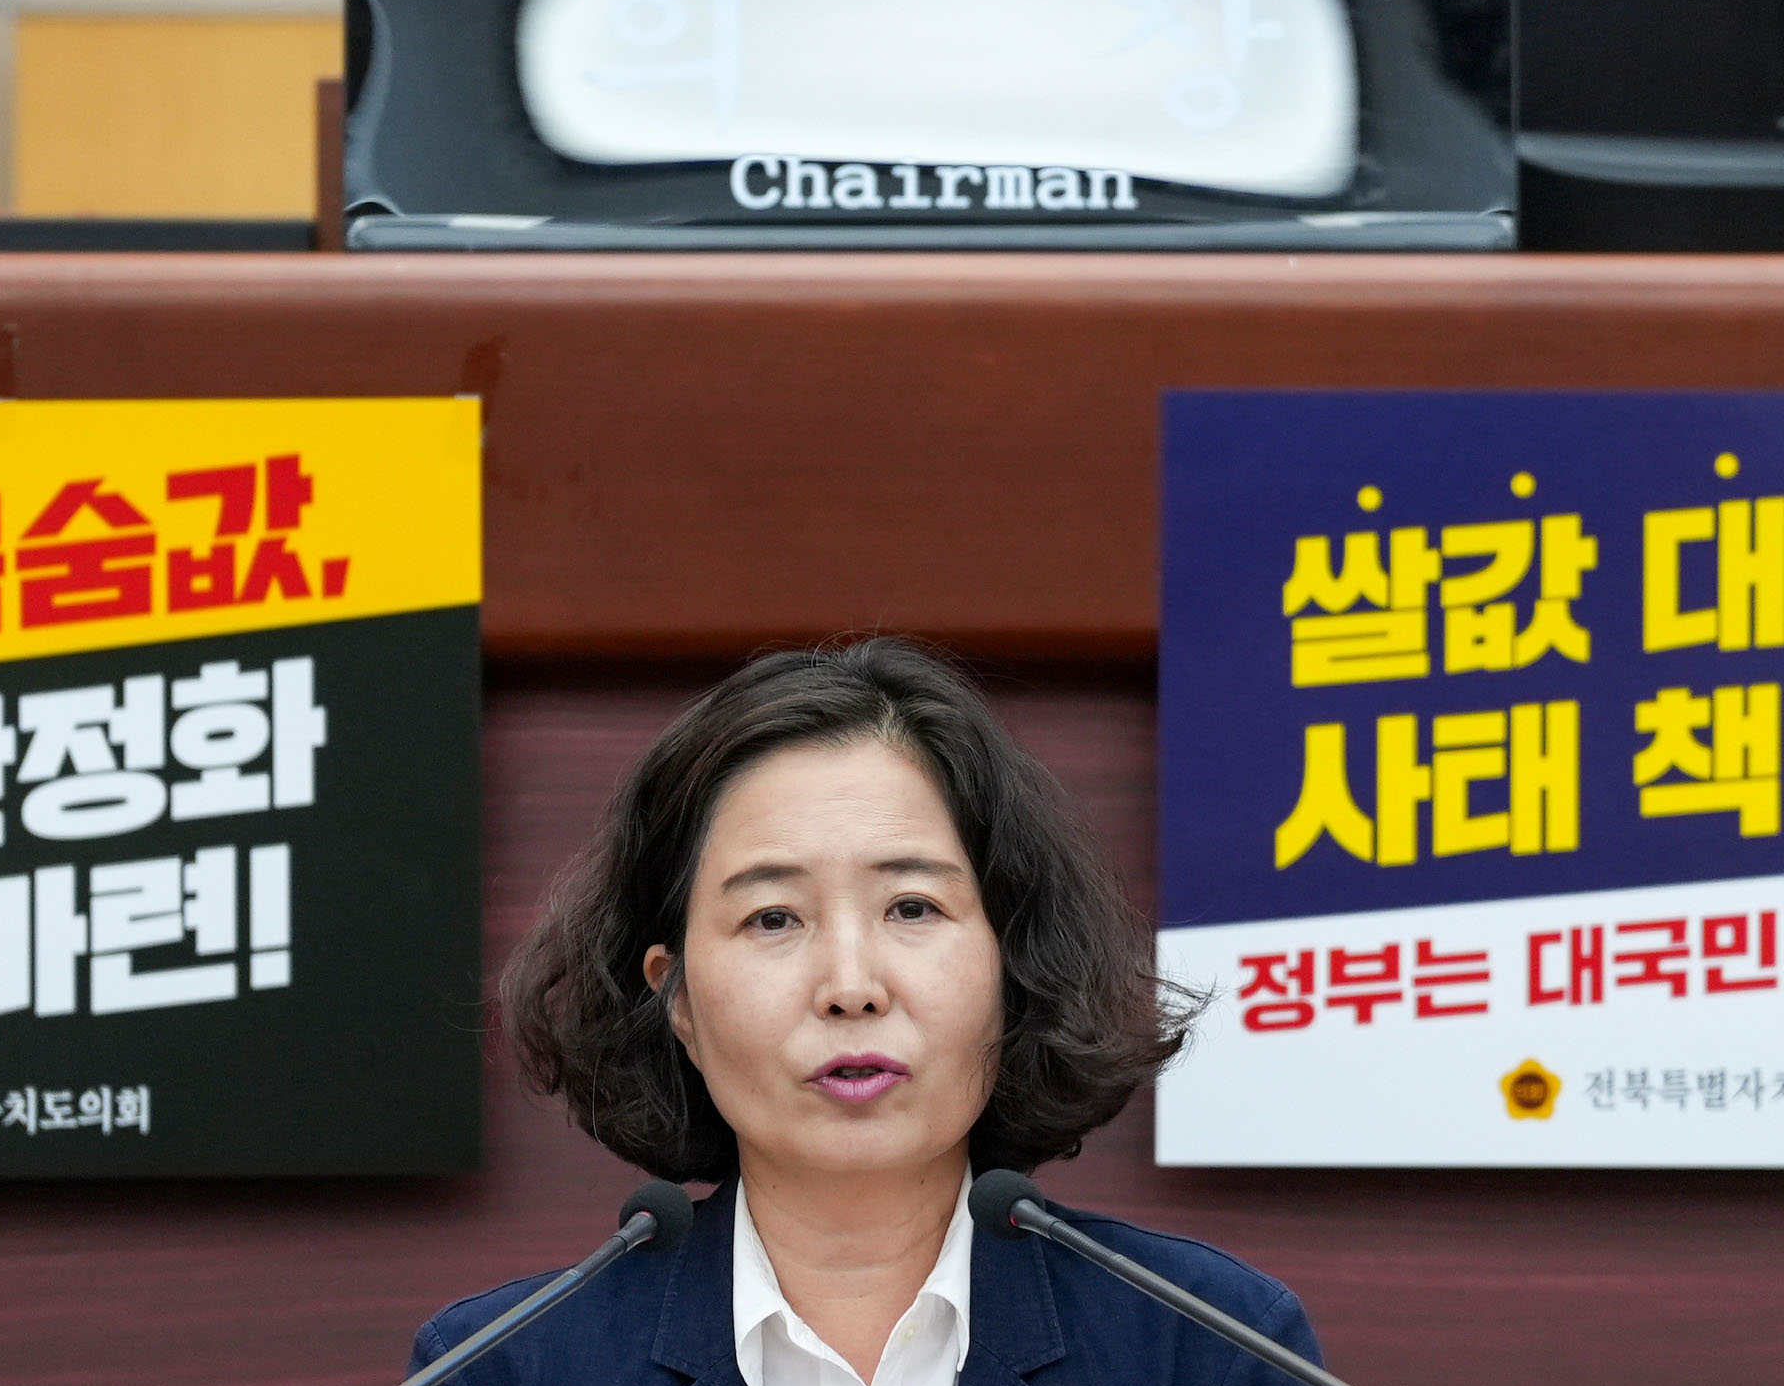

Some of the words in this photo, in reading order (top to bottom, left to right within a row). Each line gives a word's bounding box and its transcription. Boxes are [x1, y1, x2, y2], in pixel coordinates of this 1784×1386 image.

[729, 153, 1138, 212] Chairman
[1284, 513, 1597, 687] 쌀값
[1276, 701, 1579, 867] 사태
[1237, 939, 1491, 1034] 정부는
[1526, 909, 1778, 1008] 대국민
